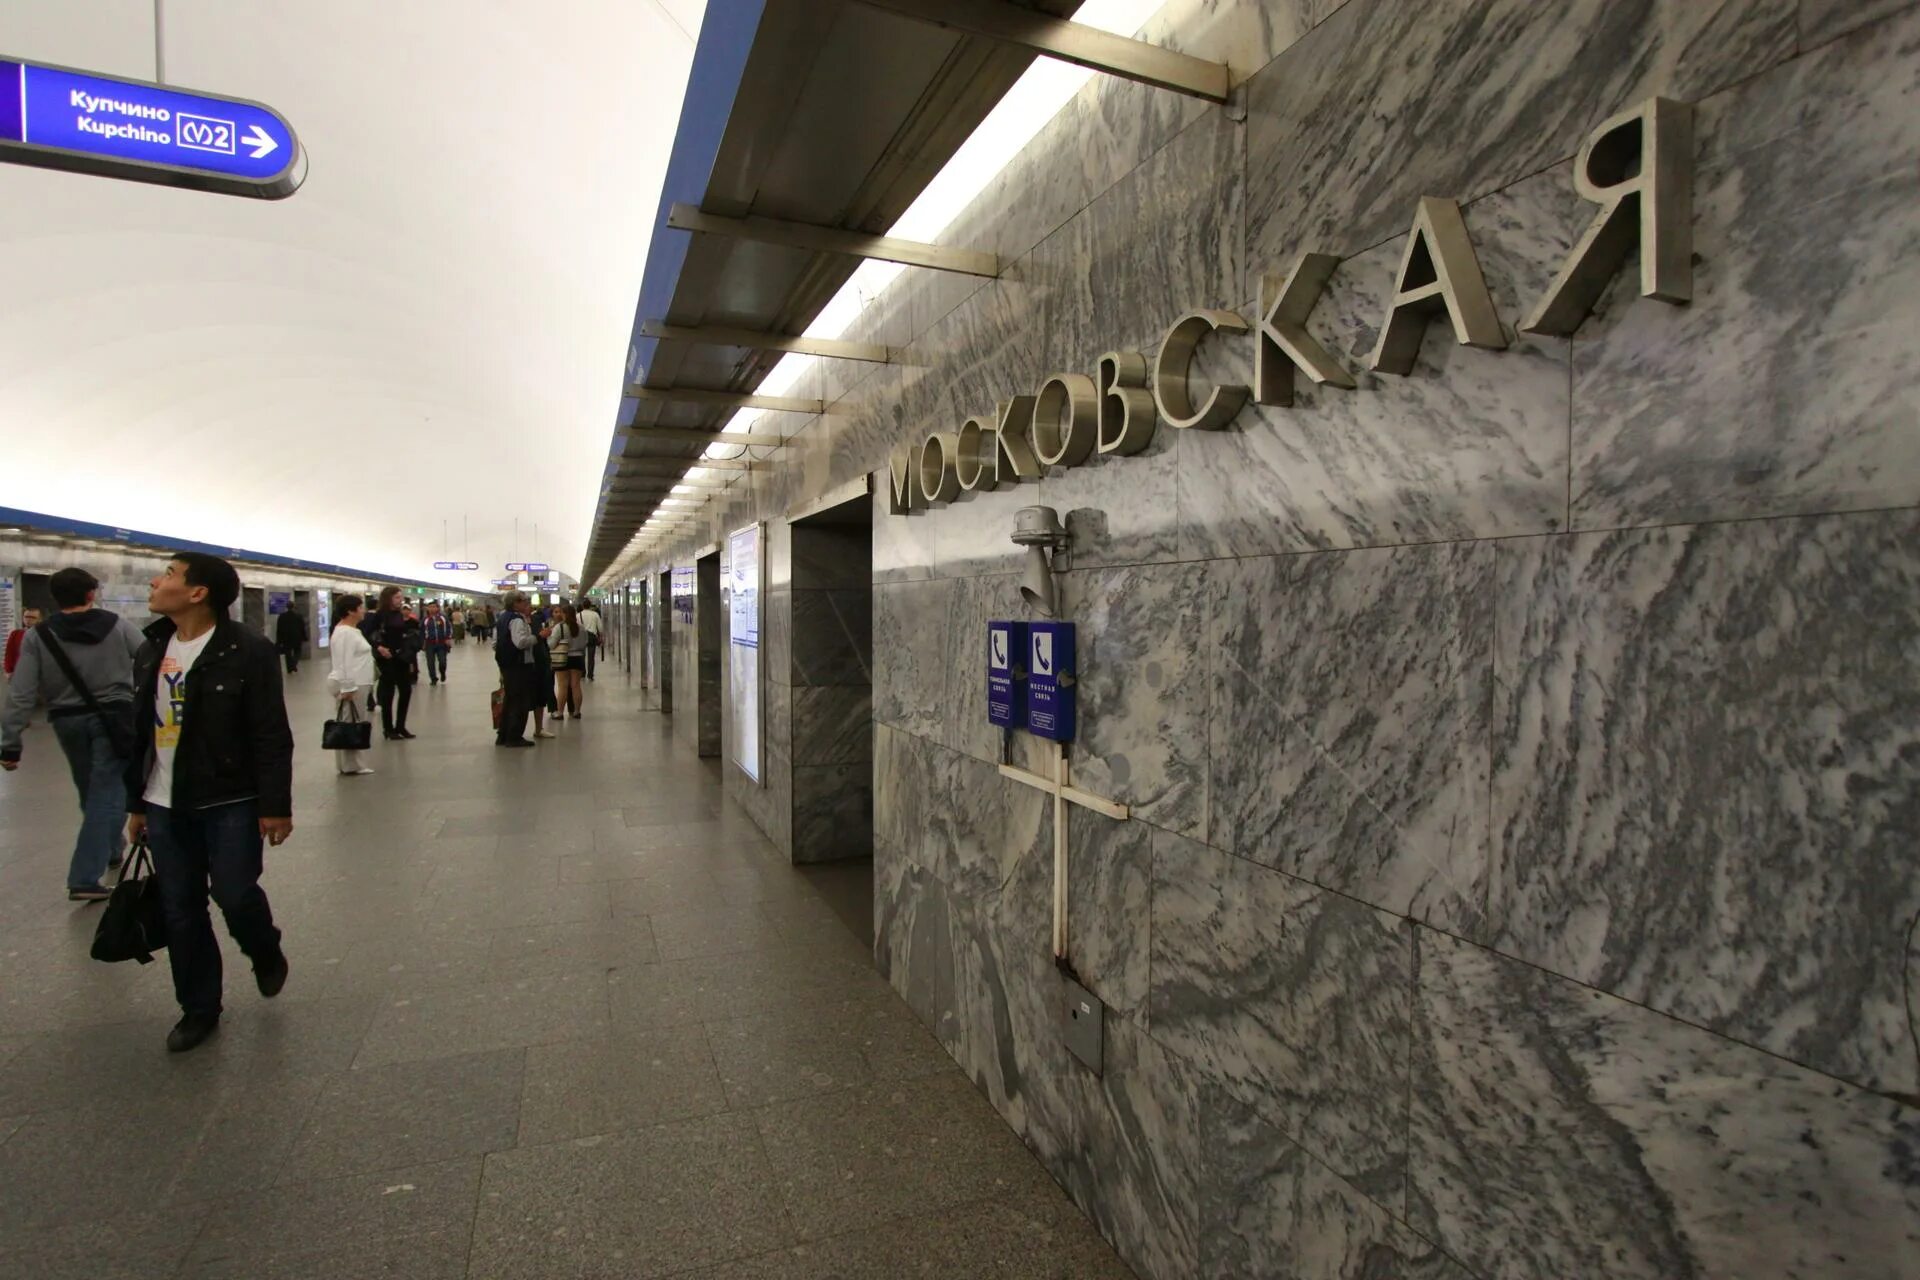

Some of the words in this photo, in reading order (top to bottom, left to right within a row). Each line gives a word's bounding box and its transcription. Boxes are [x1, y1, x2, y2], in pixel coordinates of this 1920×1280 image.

[70, 89, 171, 121] Купчино
[77, 116, 171, 144] Kupchino
[889, 97, 1693, 515] МОСКОВСКАЯ
